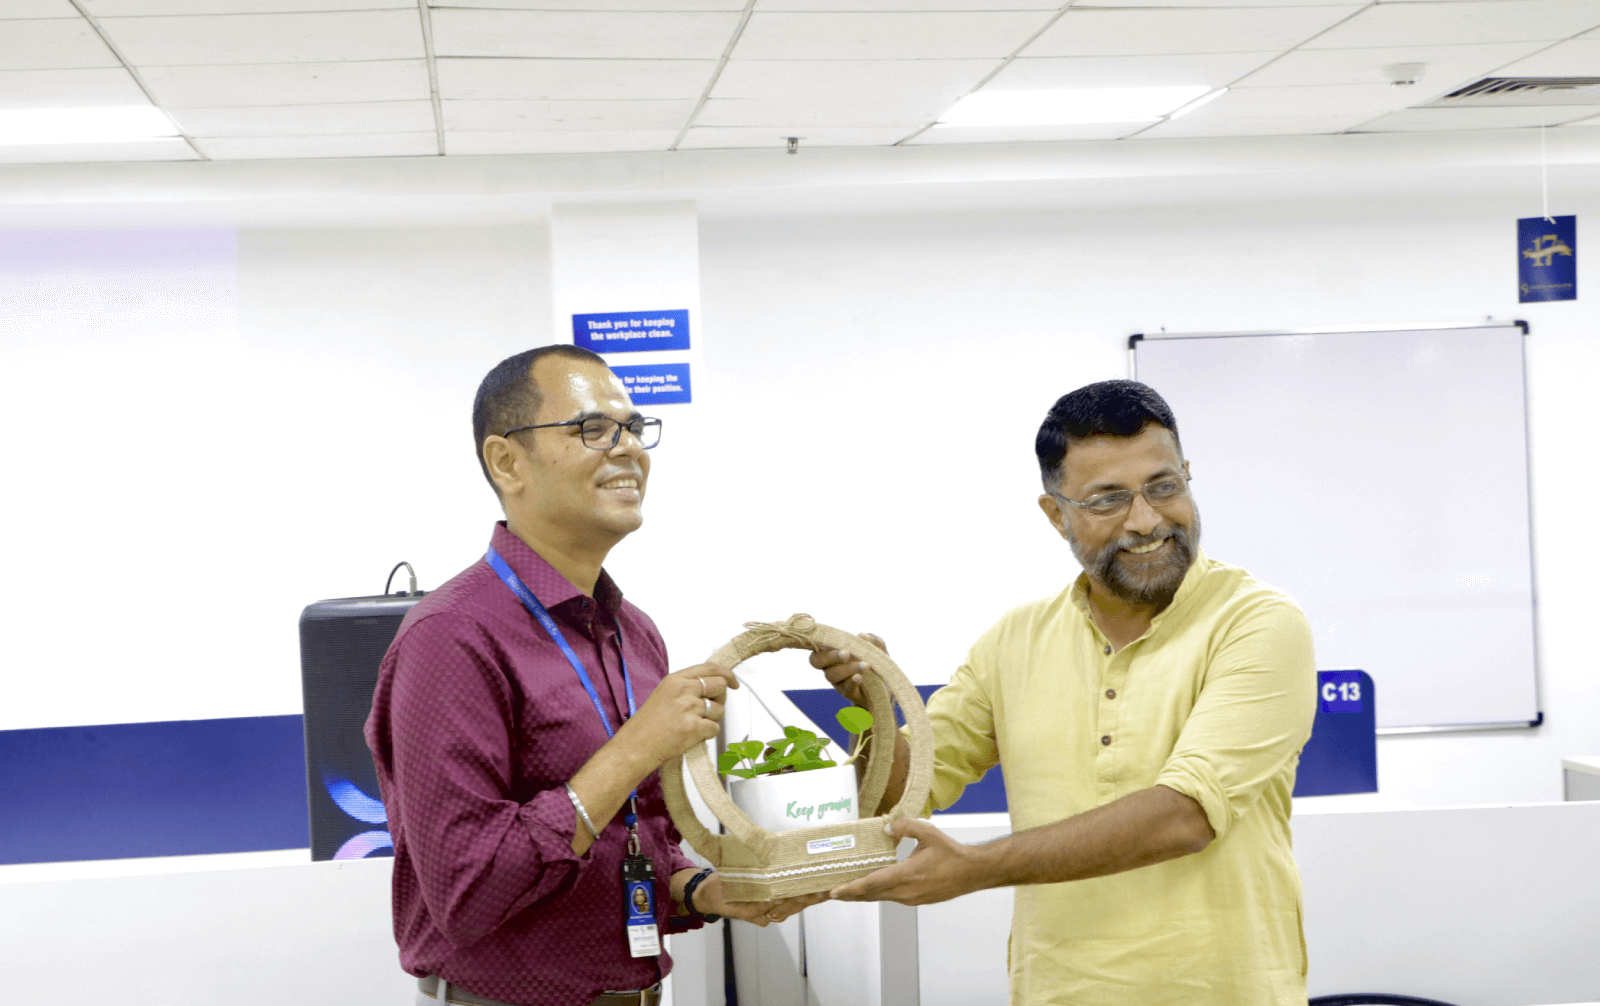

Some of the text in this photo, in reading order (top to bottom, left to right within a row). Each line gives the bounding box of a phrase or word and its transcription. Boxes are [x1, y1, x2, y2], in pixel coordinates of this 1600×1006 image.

[587, 318, 675, 330] Thank you for keeping
[590, 329, 674, 341] the workplace clean.
[624, 376, 635, 384] for
[636, 375, 665, 385] keeping
[665, 374, 678, 382] the
[634, 385, 651, 394] their
[652, 384, 684, 394] position.
[786, 797, 851, 821] Keep growing
